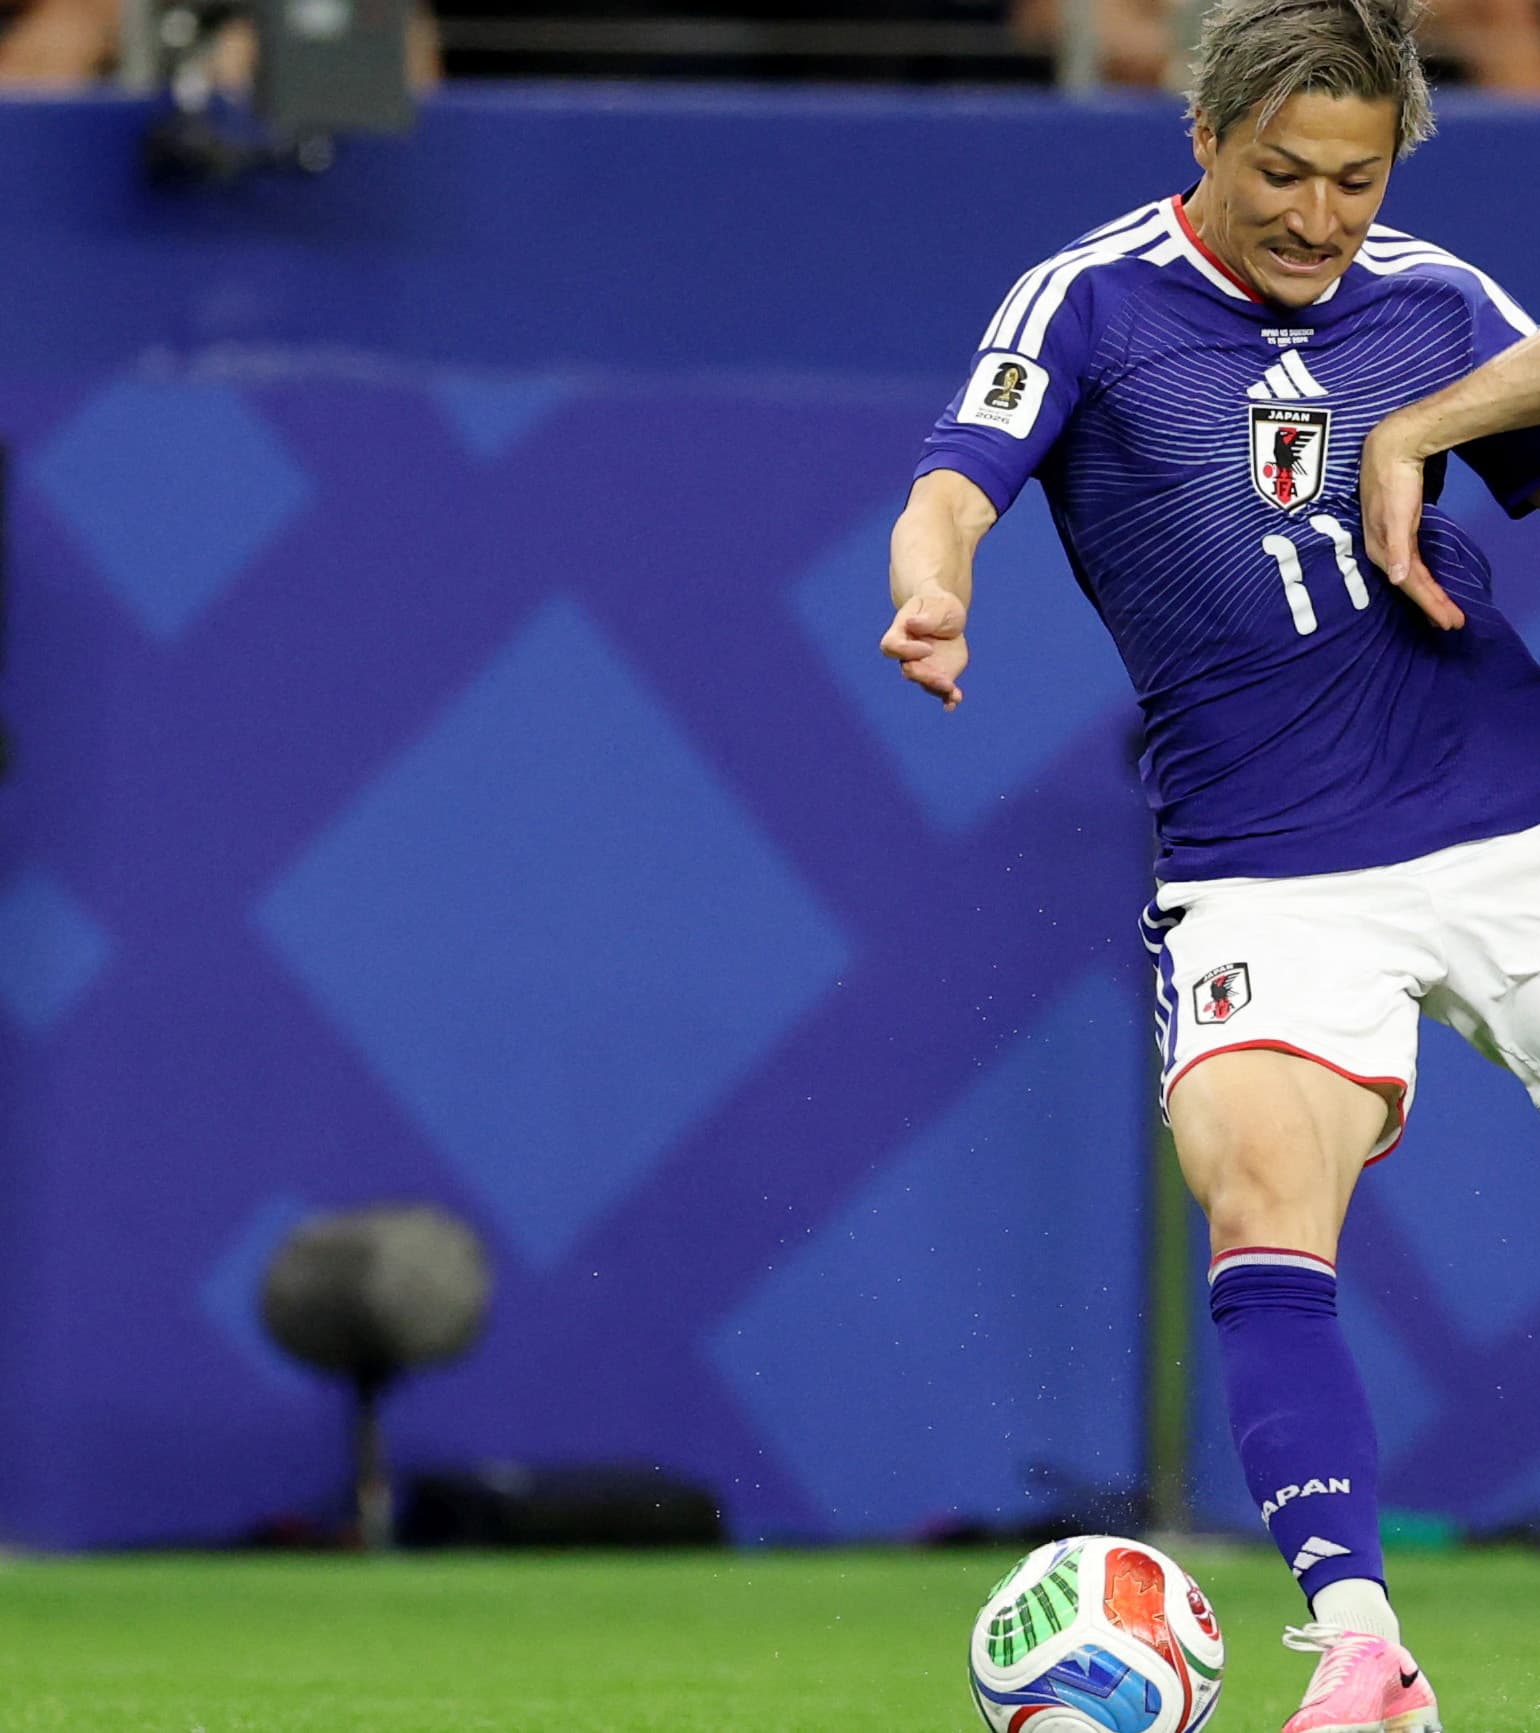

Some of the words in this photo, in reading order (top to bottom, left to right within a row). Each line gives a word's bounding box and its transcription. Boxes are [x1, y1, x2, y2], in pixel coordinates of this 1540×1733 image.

[1268, 410, 1311, 422] JAPAN
[1271, 480, 1298, 498] JFA
[1262, 513, 1370, 636] 11
[1261, 1477, 1351, 1532] APAN
